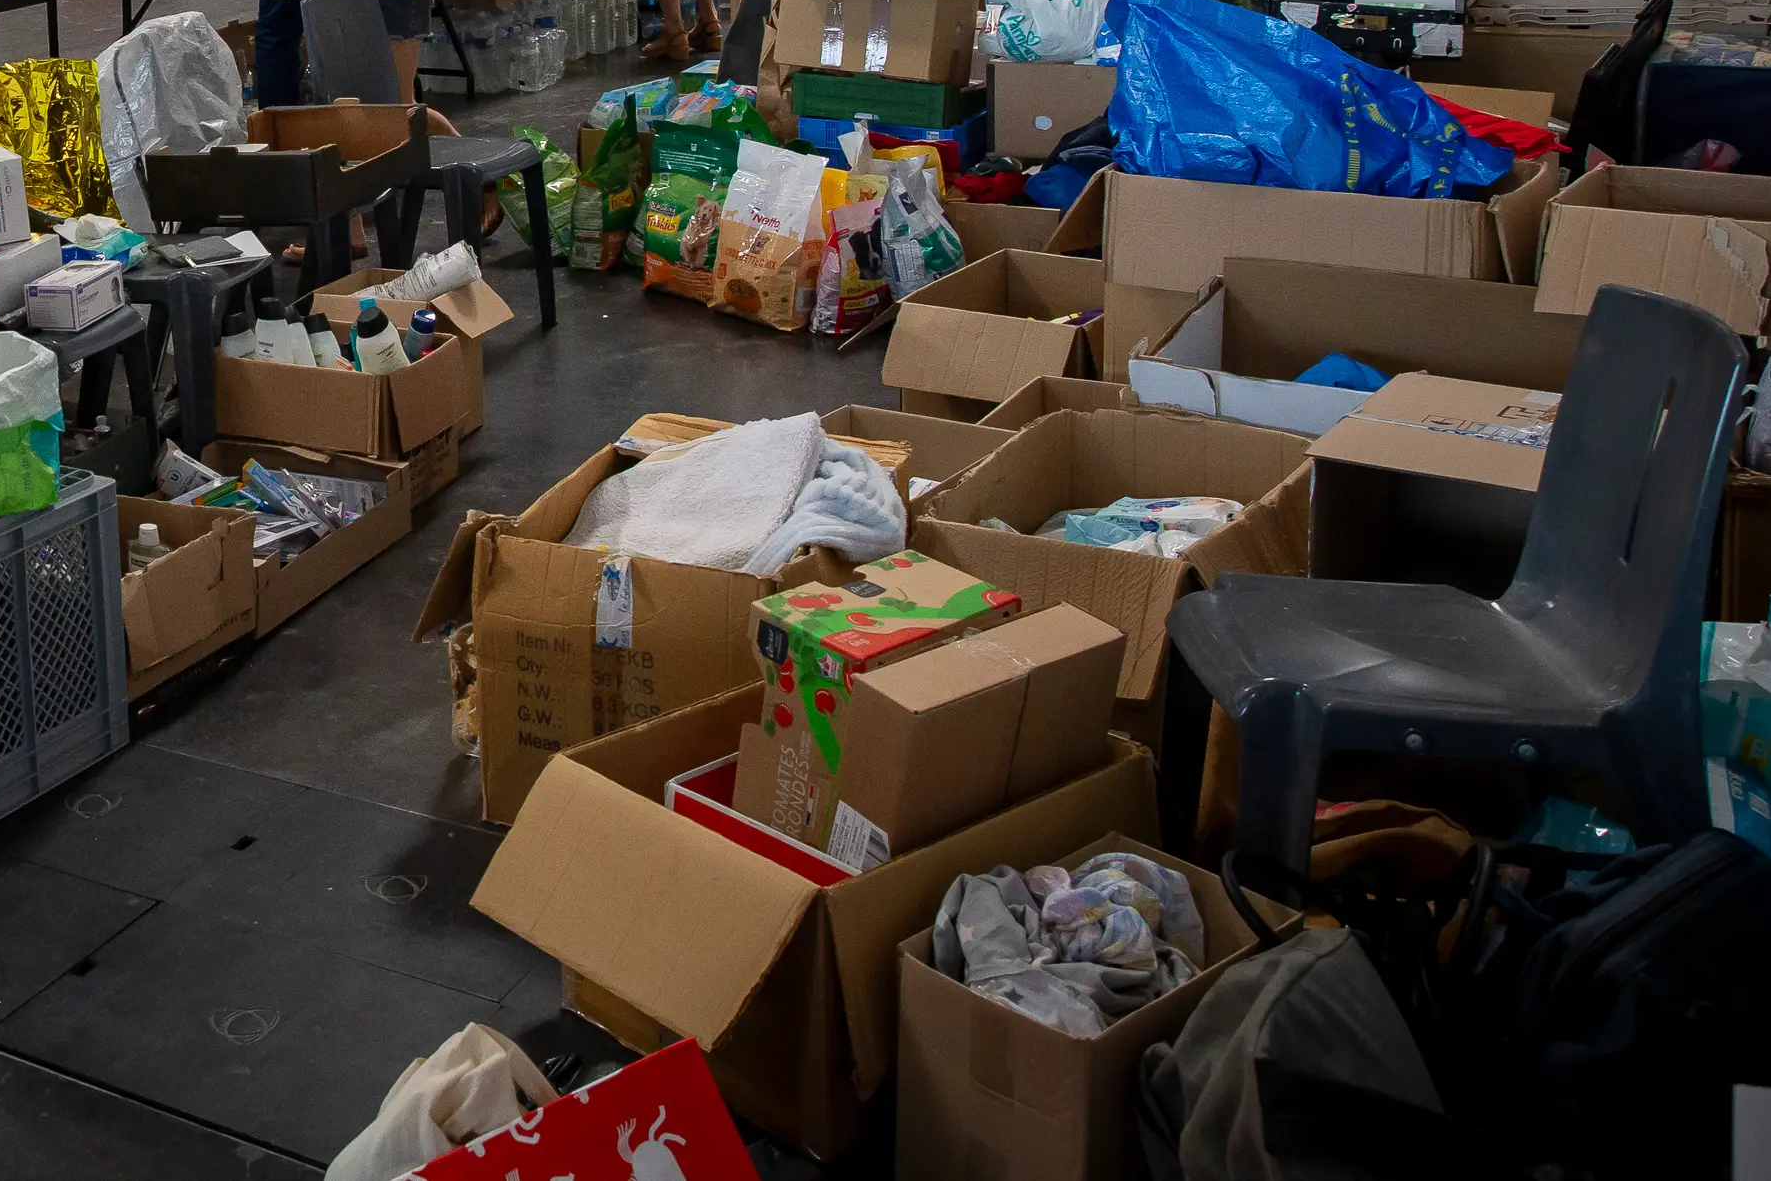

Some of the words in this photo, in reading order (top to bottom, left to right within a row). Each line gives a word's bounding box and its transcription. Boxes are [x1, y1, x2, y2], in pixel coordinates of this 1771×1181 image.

[515, 630, 549, 651] Item
[770, 744, 796, 833] TOMATES
[785, 756, 809, 838] RONDES
